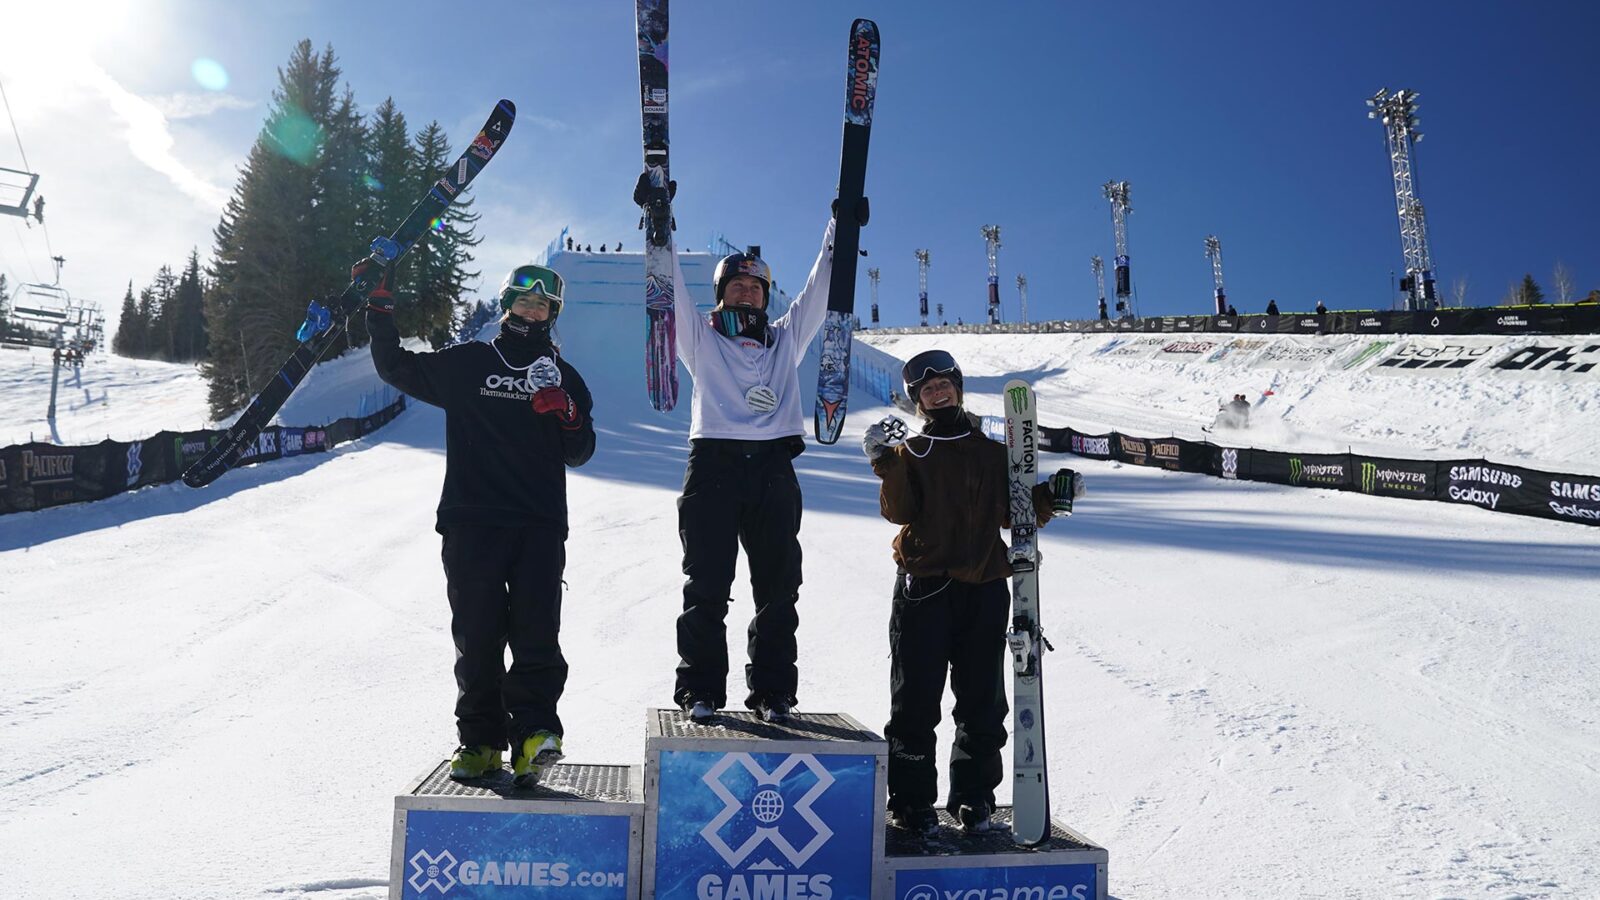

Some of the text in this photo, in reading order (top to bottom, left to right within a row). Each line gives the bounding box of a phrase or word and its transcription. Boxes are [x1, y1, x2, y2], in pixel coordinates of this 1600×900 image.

[852, 35, 871, 111] ATOMIC
[486, 374, 537, 394] OAKL
[1022, 419, 1034, 474] FACTION
[1120, 436, 1147, 452] PACIFICO
[1152, 443, 1179, 457] PACIFICO
[21, 450, 75, 481] PACIFICO
[1303, 463, 1344, 476] MONSTER
[1376, 468, 1426, 484] MONSTER
[1382, 482, 1418, 491] ENERGY
[1450, 466, 1522, 489] SAMSUNG
[1449, 486, 1500, 509] Galaxy
[696, 873, 833, 900] GAMES
